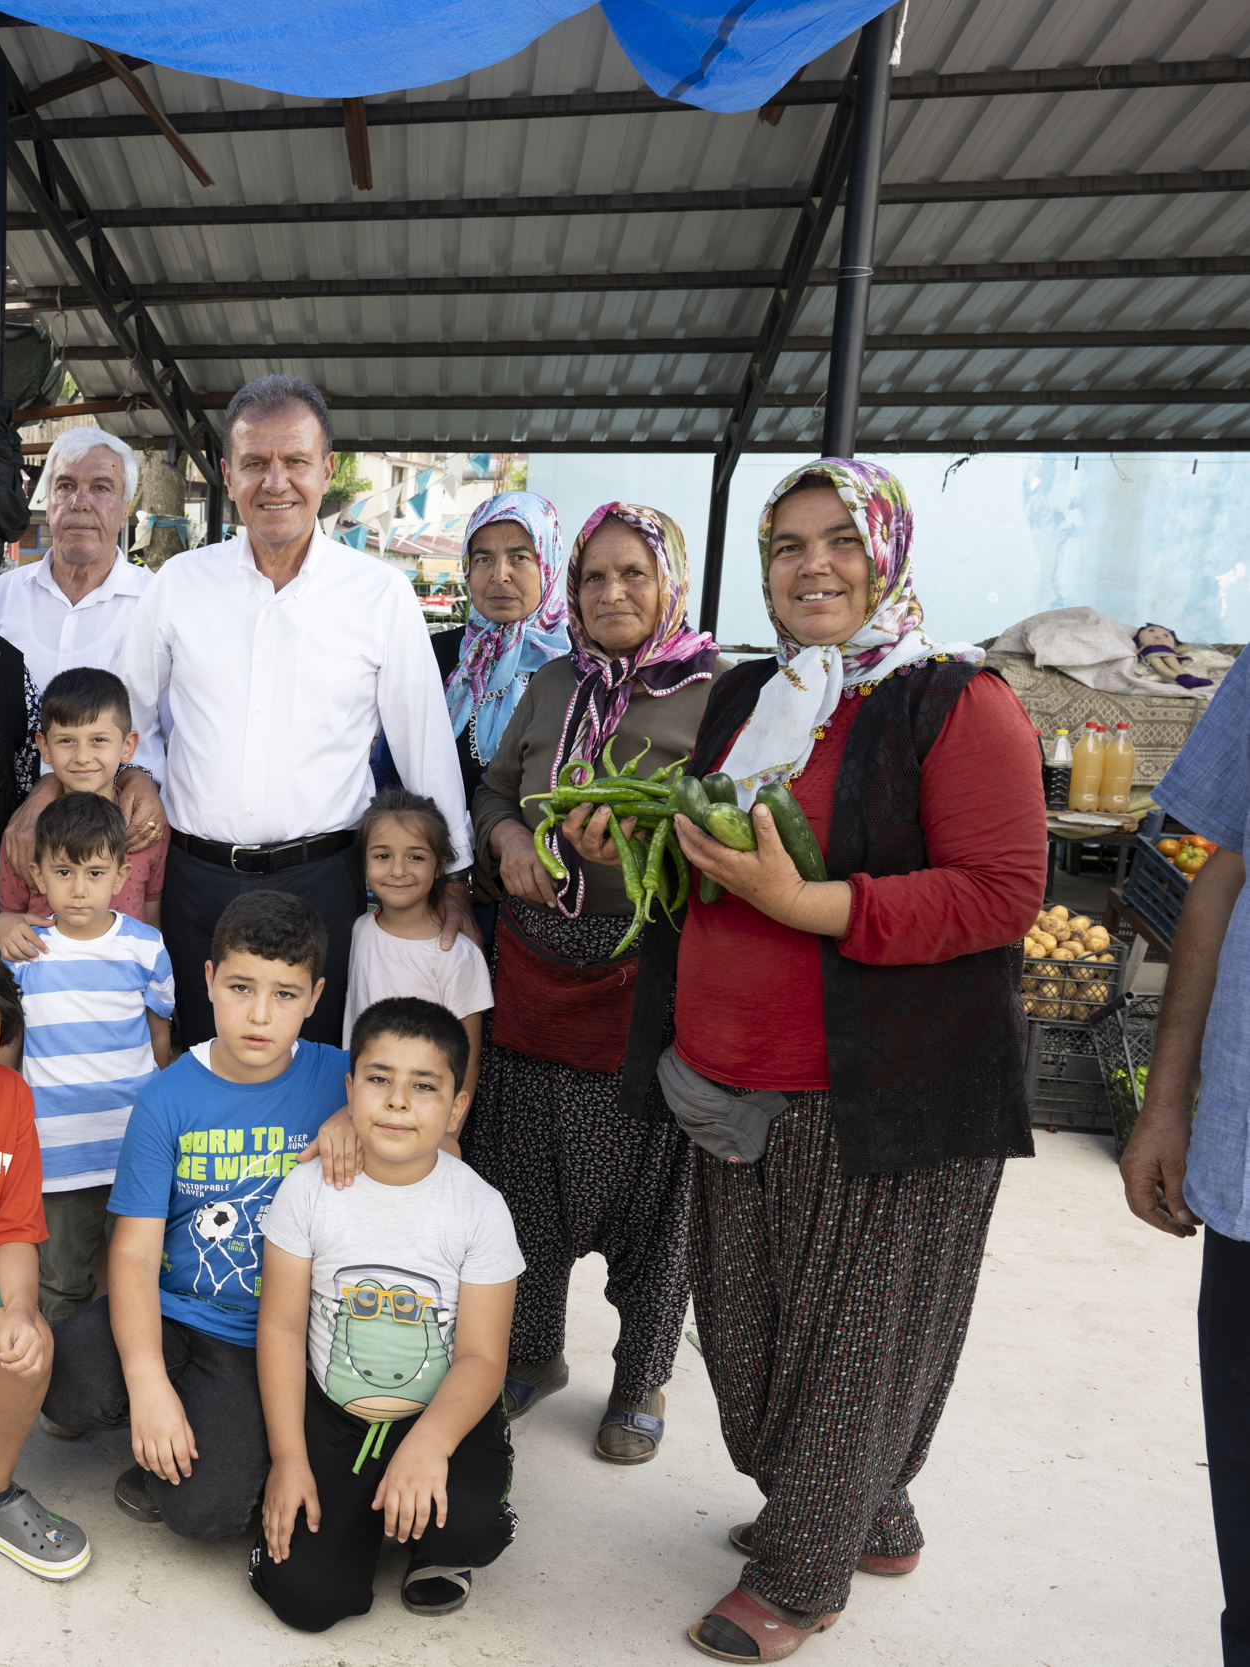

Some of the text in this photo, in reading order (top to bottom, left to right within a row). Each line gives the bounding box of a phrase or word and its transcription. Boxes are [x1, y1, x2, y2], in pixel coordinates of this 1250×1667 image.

[179, 1127, 284, 1154] BORN TO
[288, 1134, 308, 1143] KEEP
[287, 1141, 312, 1150] RUNN
[177, 1154, 207, 1180] BE
[177, 1180, 230, 1192] UNSTOPPABLE
[178, 1187, 205, 1198] PLAYER
[227, 1245, 246, 1254] SHOOT
